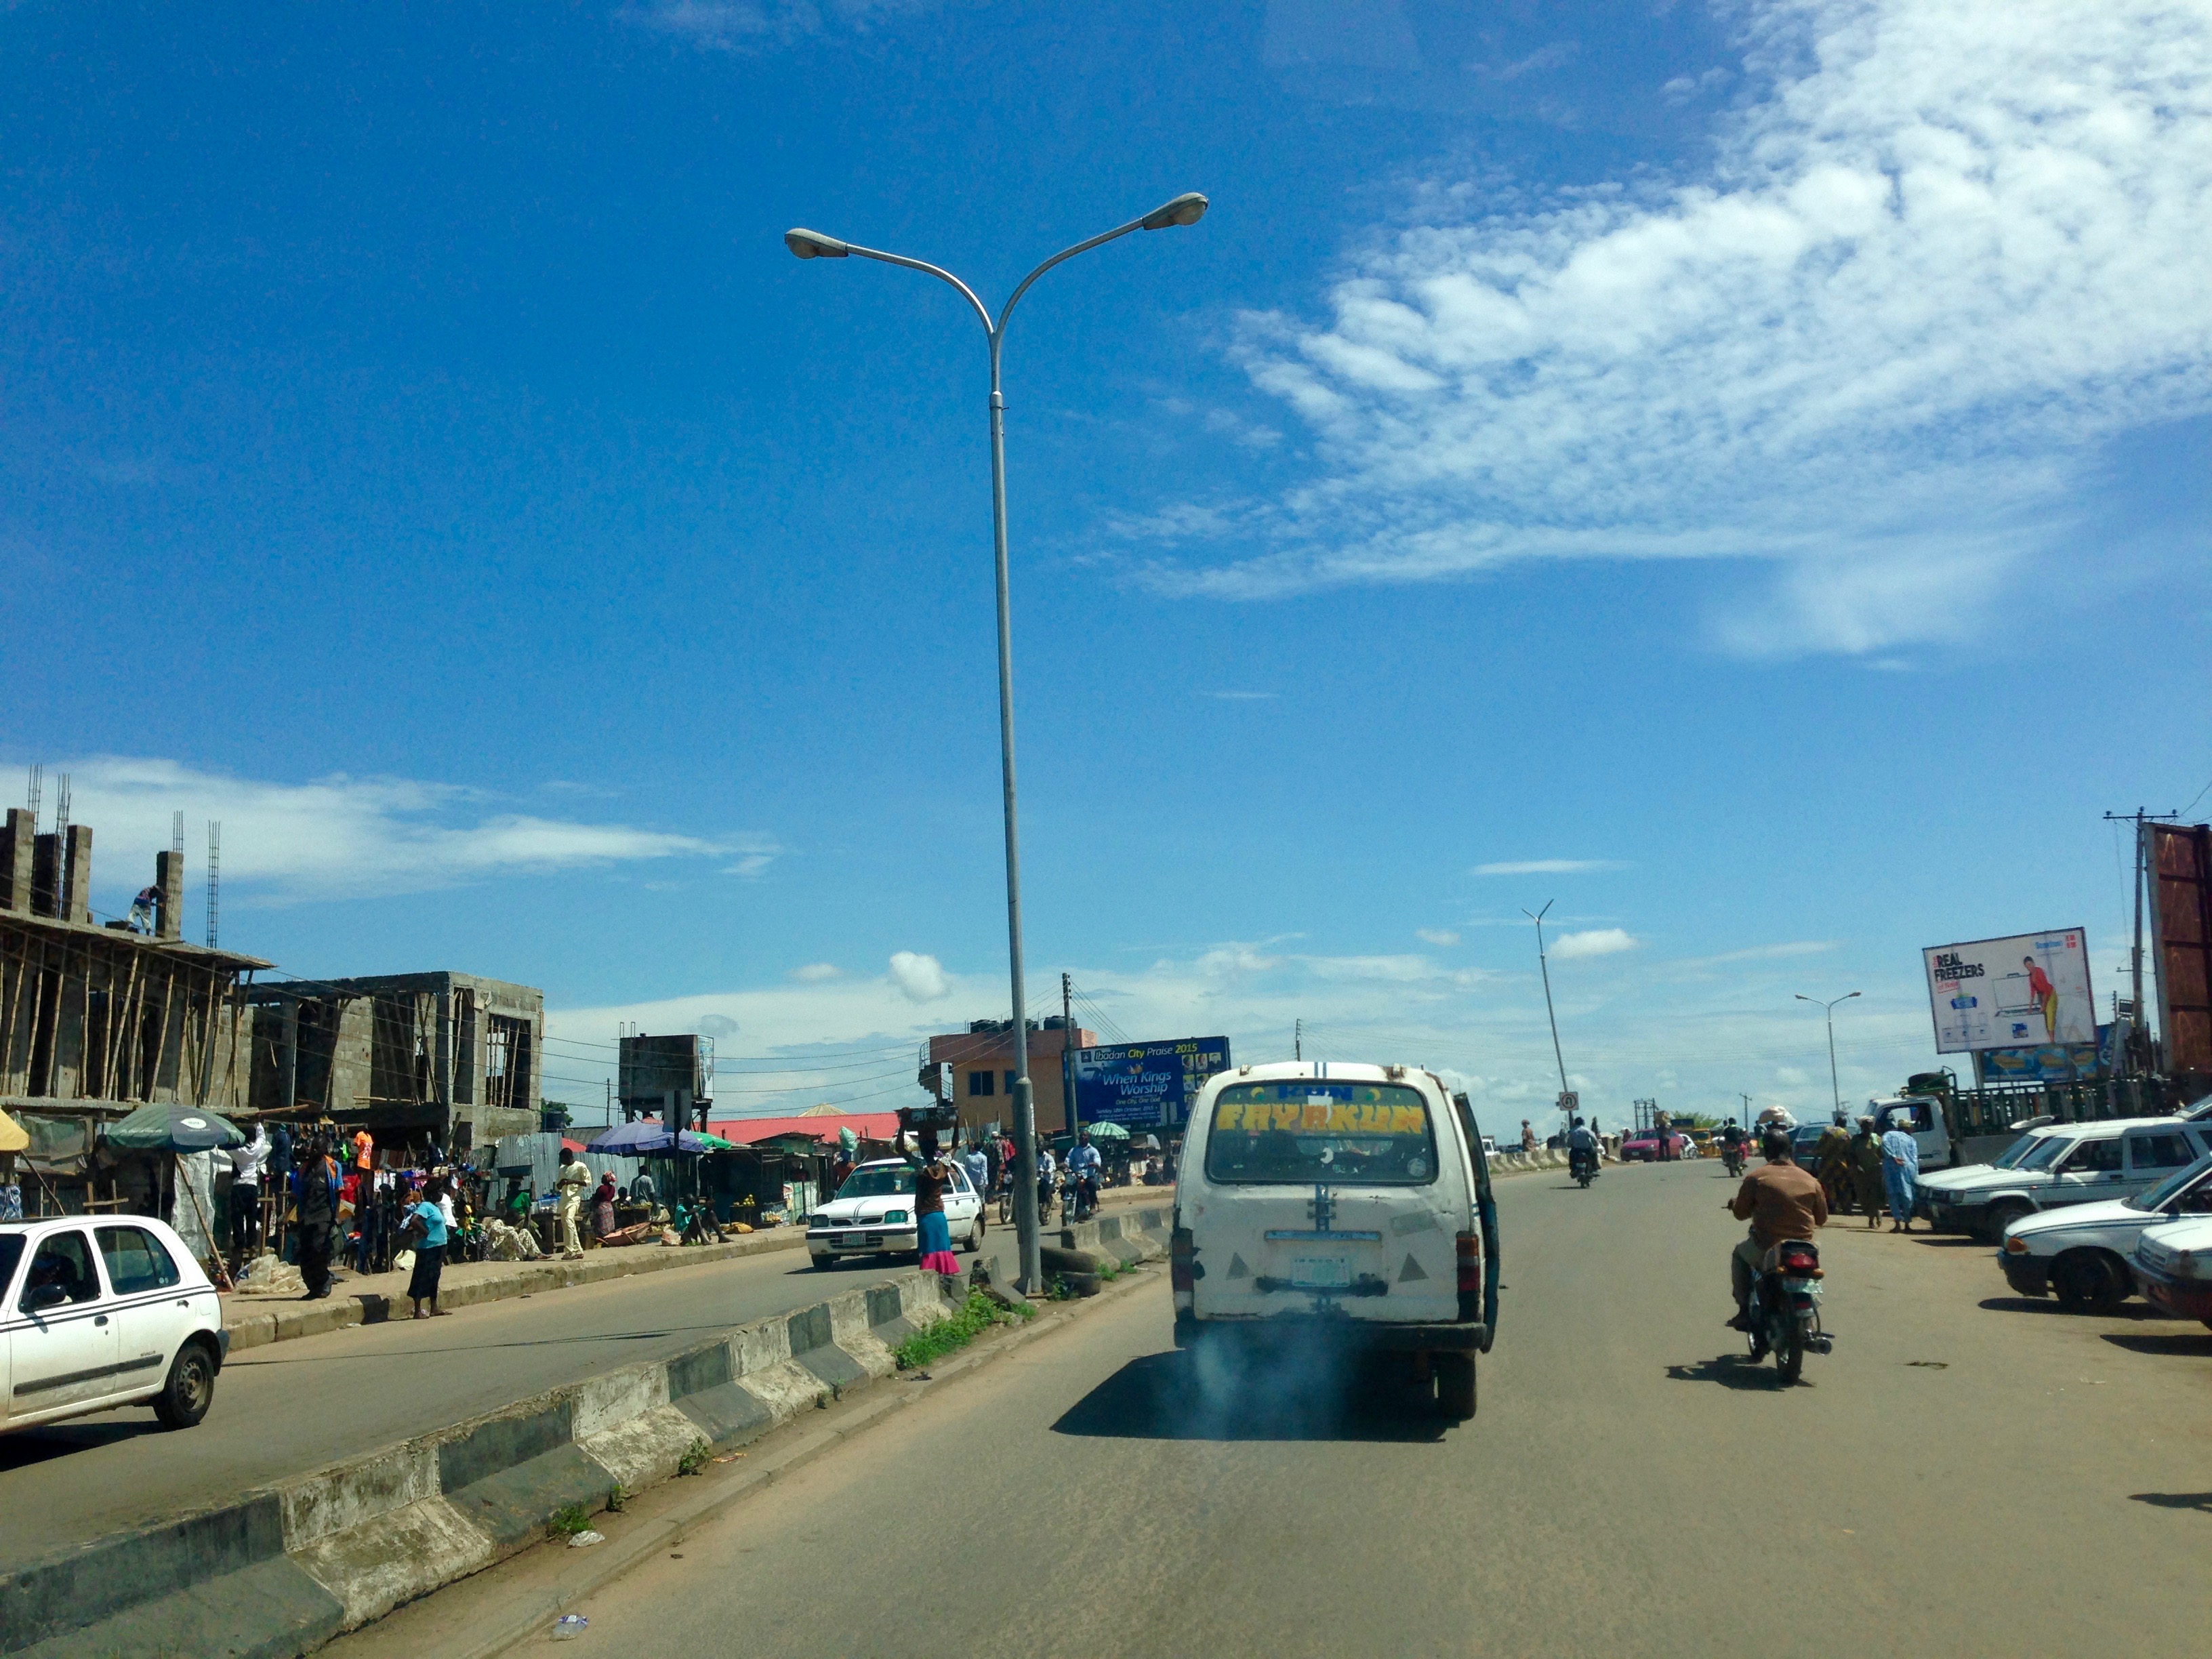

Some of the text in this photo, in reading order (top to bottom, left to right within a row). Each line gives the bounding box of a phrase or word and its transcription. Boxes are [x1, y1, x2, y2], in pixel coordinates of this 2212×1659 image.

[1937, 953, 1963, 967] REAL
[1934, 963, 1985, 981] FREEZERS
[1095, 1043, 1197, 1061] Ibadan City Praise 2015
[1103, 1071, 1172, 1086] When Kings
[1120, 1082, 1168, 1095] Worship
[1216, 1104, 1426, 1134] FAYAKUN
